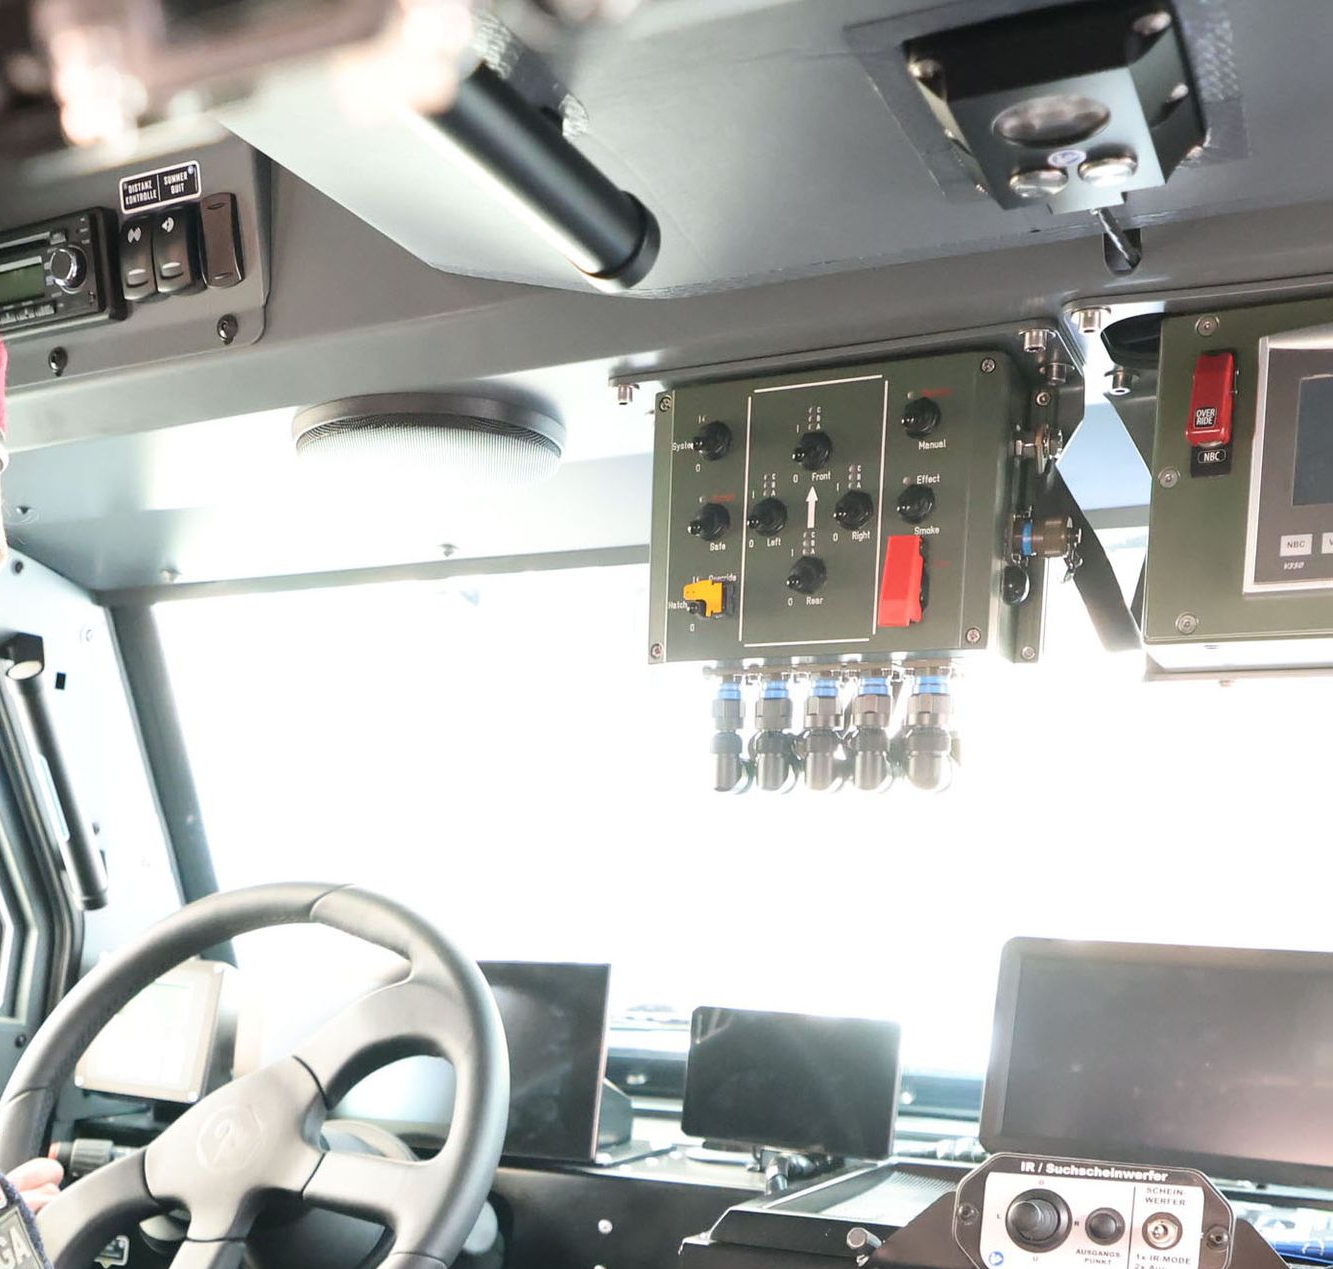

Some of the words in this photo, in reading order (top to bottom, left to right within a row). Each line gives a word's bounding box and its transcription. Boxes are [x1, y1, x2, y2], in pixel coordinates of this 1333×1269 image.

[164, 170, 188, 185] SUMMER
[128, 180, 153, 194] DISTANZ
[125, 189, 158, 205] KONTROLLE
[1196, 408, 1216, 418] OVER
[1196, 416, 1214, 426] RIDE
[918, 439, 947, 450] Manual
[1203, 451, 1221, 462] NBC
[811, 472, 832, 482] Front
[916, 474, 941, 484] Effect
[914, 526, 940, 536] Smoke
[851, 531, 871, 542] Right
[709, 542, 726, 551] Safe
[766, 538, 782, 548] Left
[1286, 540, 1306, 549] NBC
[668, 601, 689, 610] Hatch
[806, 596, 824, 606] Rear
[1020, 1161, 1036, 1173] IR
[1045, 1163, 1169, 1183] Suchscheinwerfer
[1145, 1196, 1186, 1207] WERFER
[1084, 1257, 1113, 1266] PUNKT
